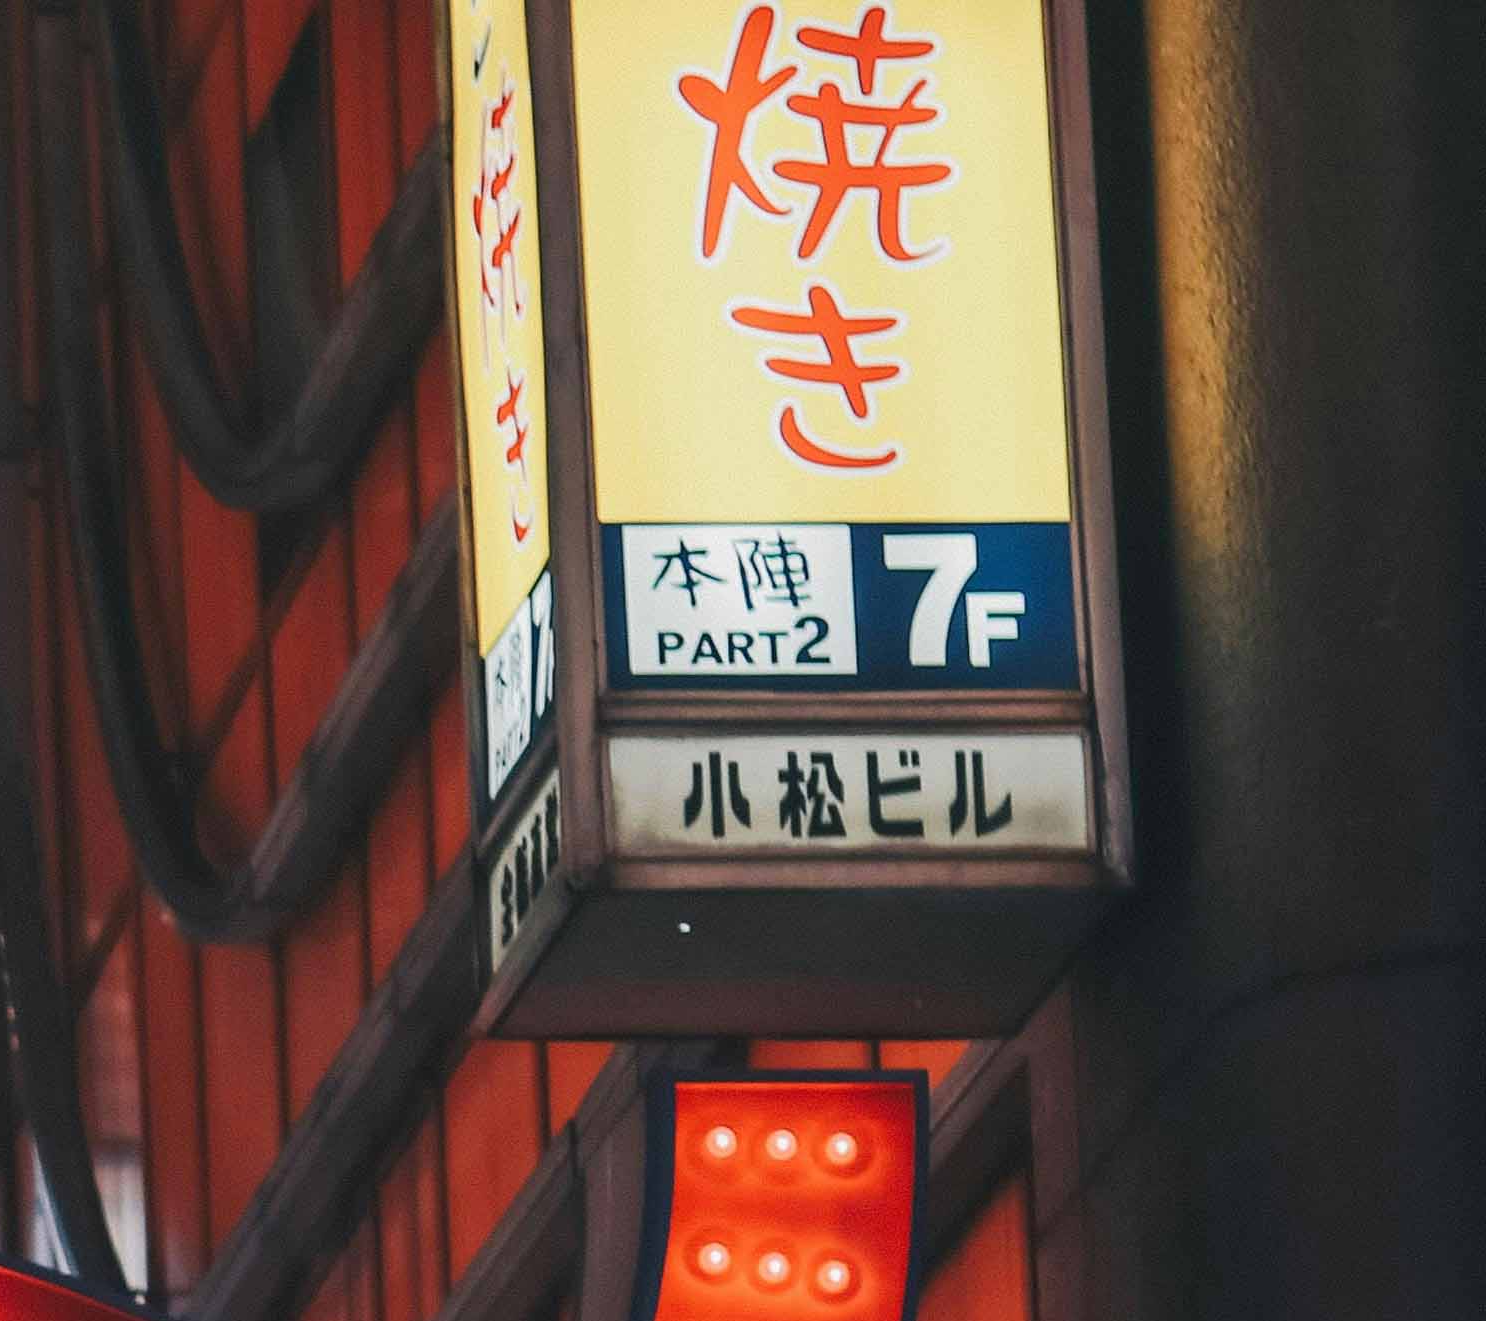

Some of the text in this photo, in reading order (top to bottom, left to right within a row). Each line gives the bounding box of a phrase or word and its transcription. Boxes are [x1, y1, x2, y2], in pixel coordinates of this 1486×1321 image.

[676, 3, 960, 472] 焼き
[653, 537, 813, 613] 本陣
[883, 533, 1026, 669] 7F
[657, 616, 832, 666] PART2
[683, 749, 1014, 839] 小松ビル
